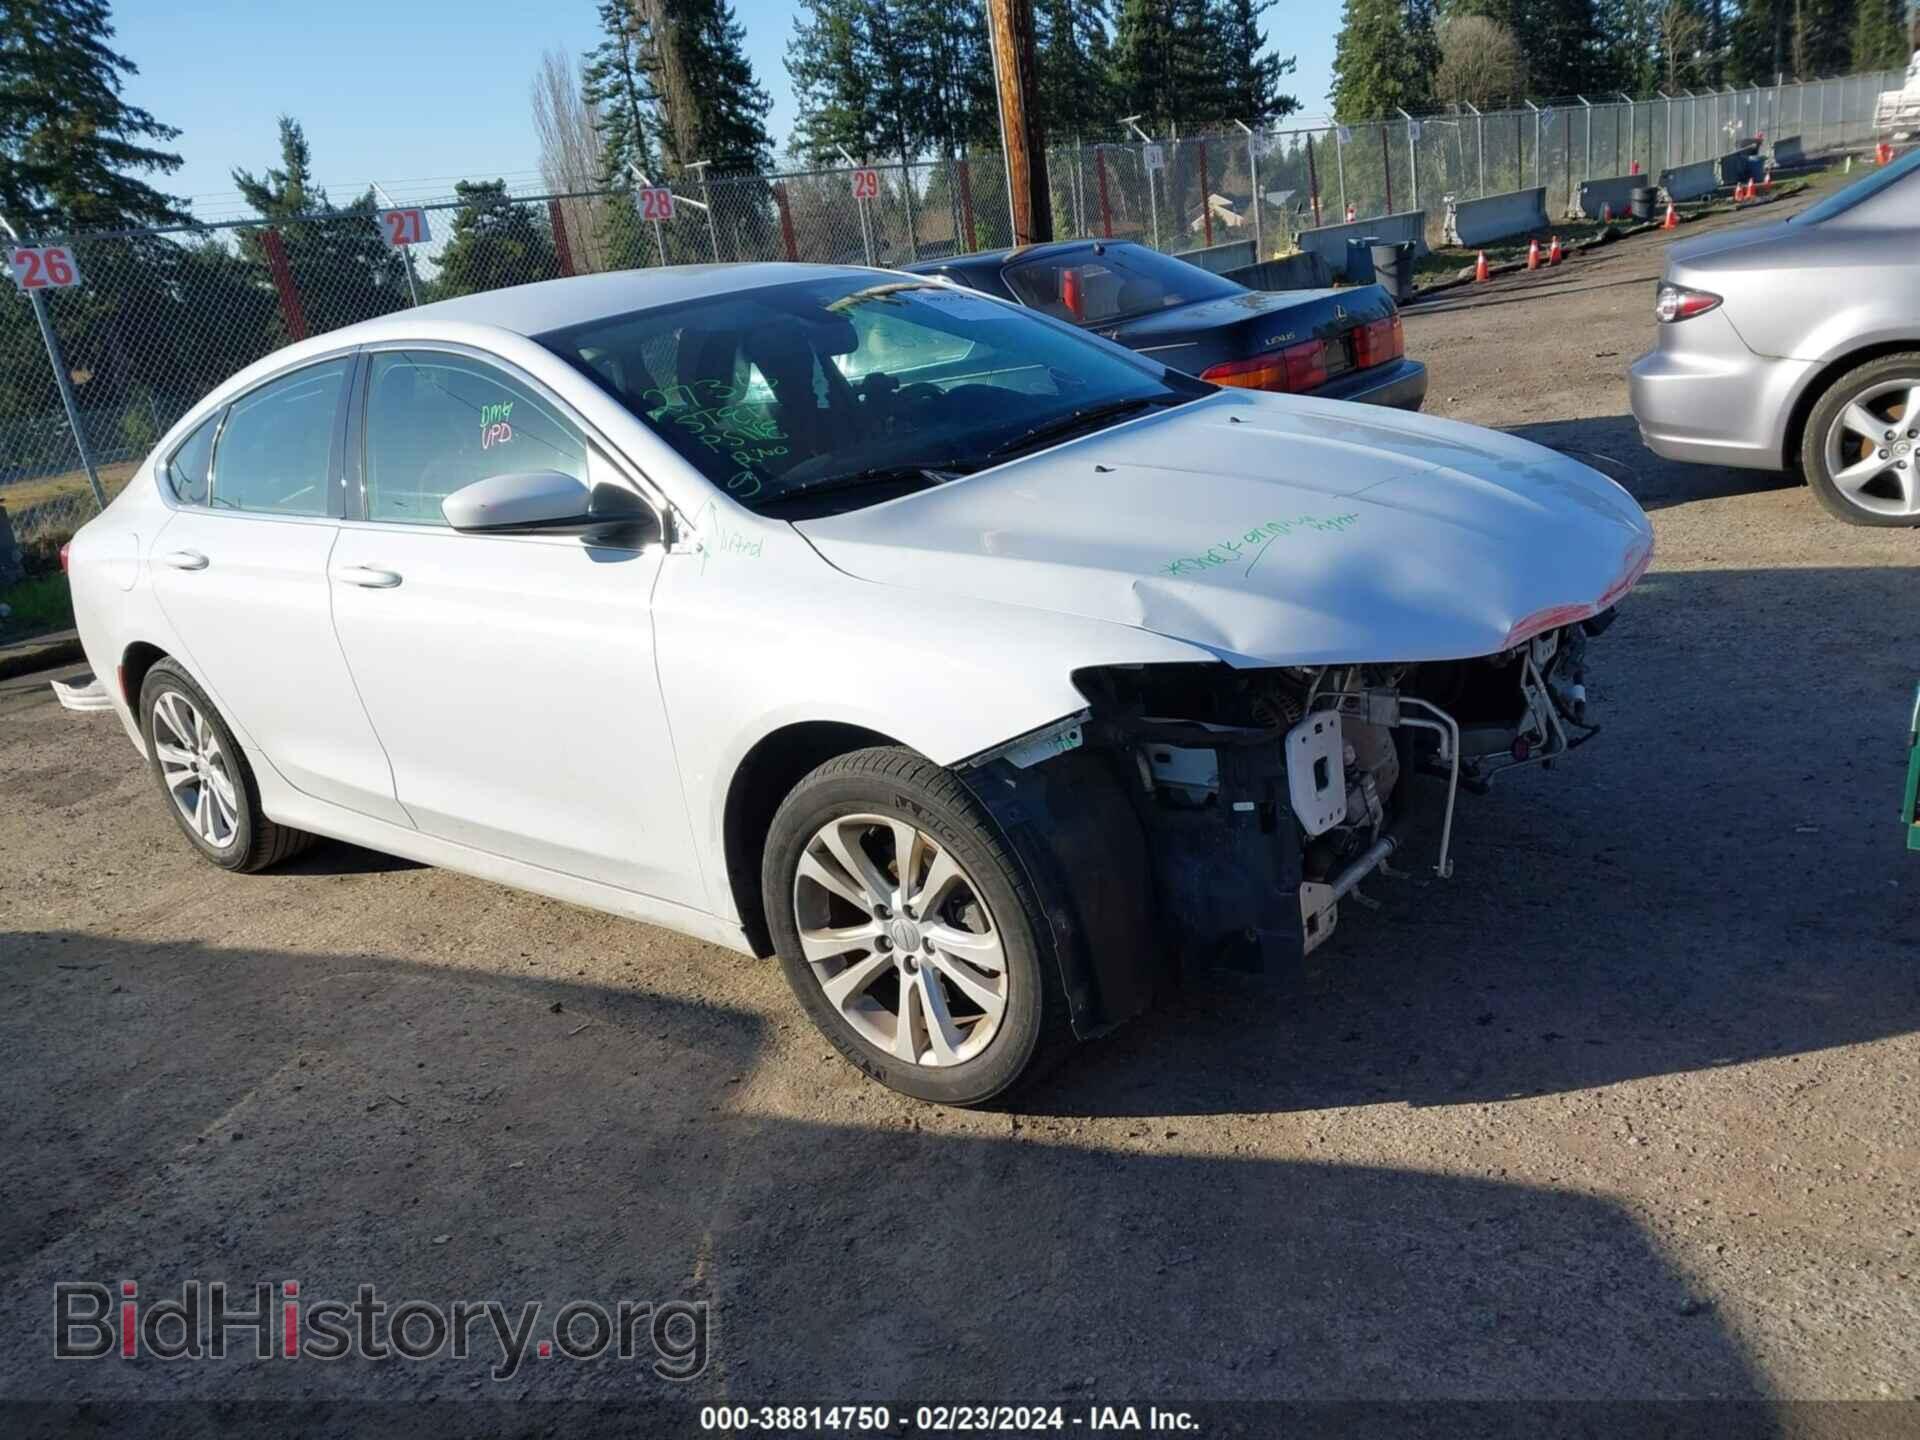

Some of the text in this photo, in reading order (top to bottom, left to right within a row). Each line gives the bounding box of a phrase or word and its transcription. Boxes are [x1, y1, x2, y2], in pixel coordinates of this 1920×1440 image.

[855, 171, 877, 196] 29
[641, 190, 671, 218] 28
[386, 210, 420, 244] 27
[15, 248, 73, 287] 26
